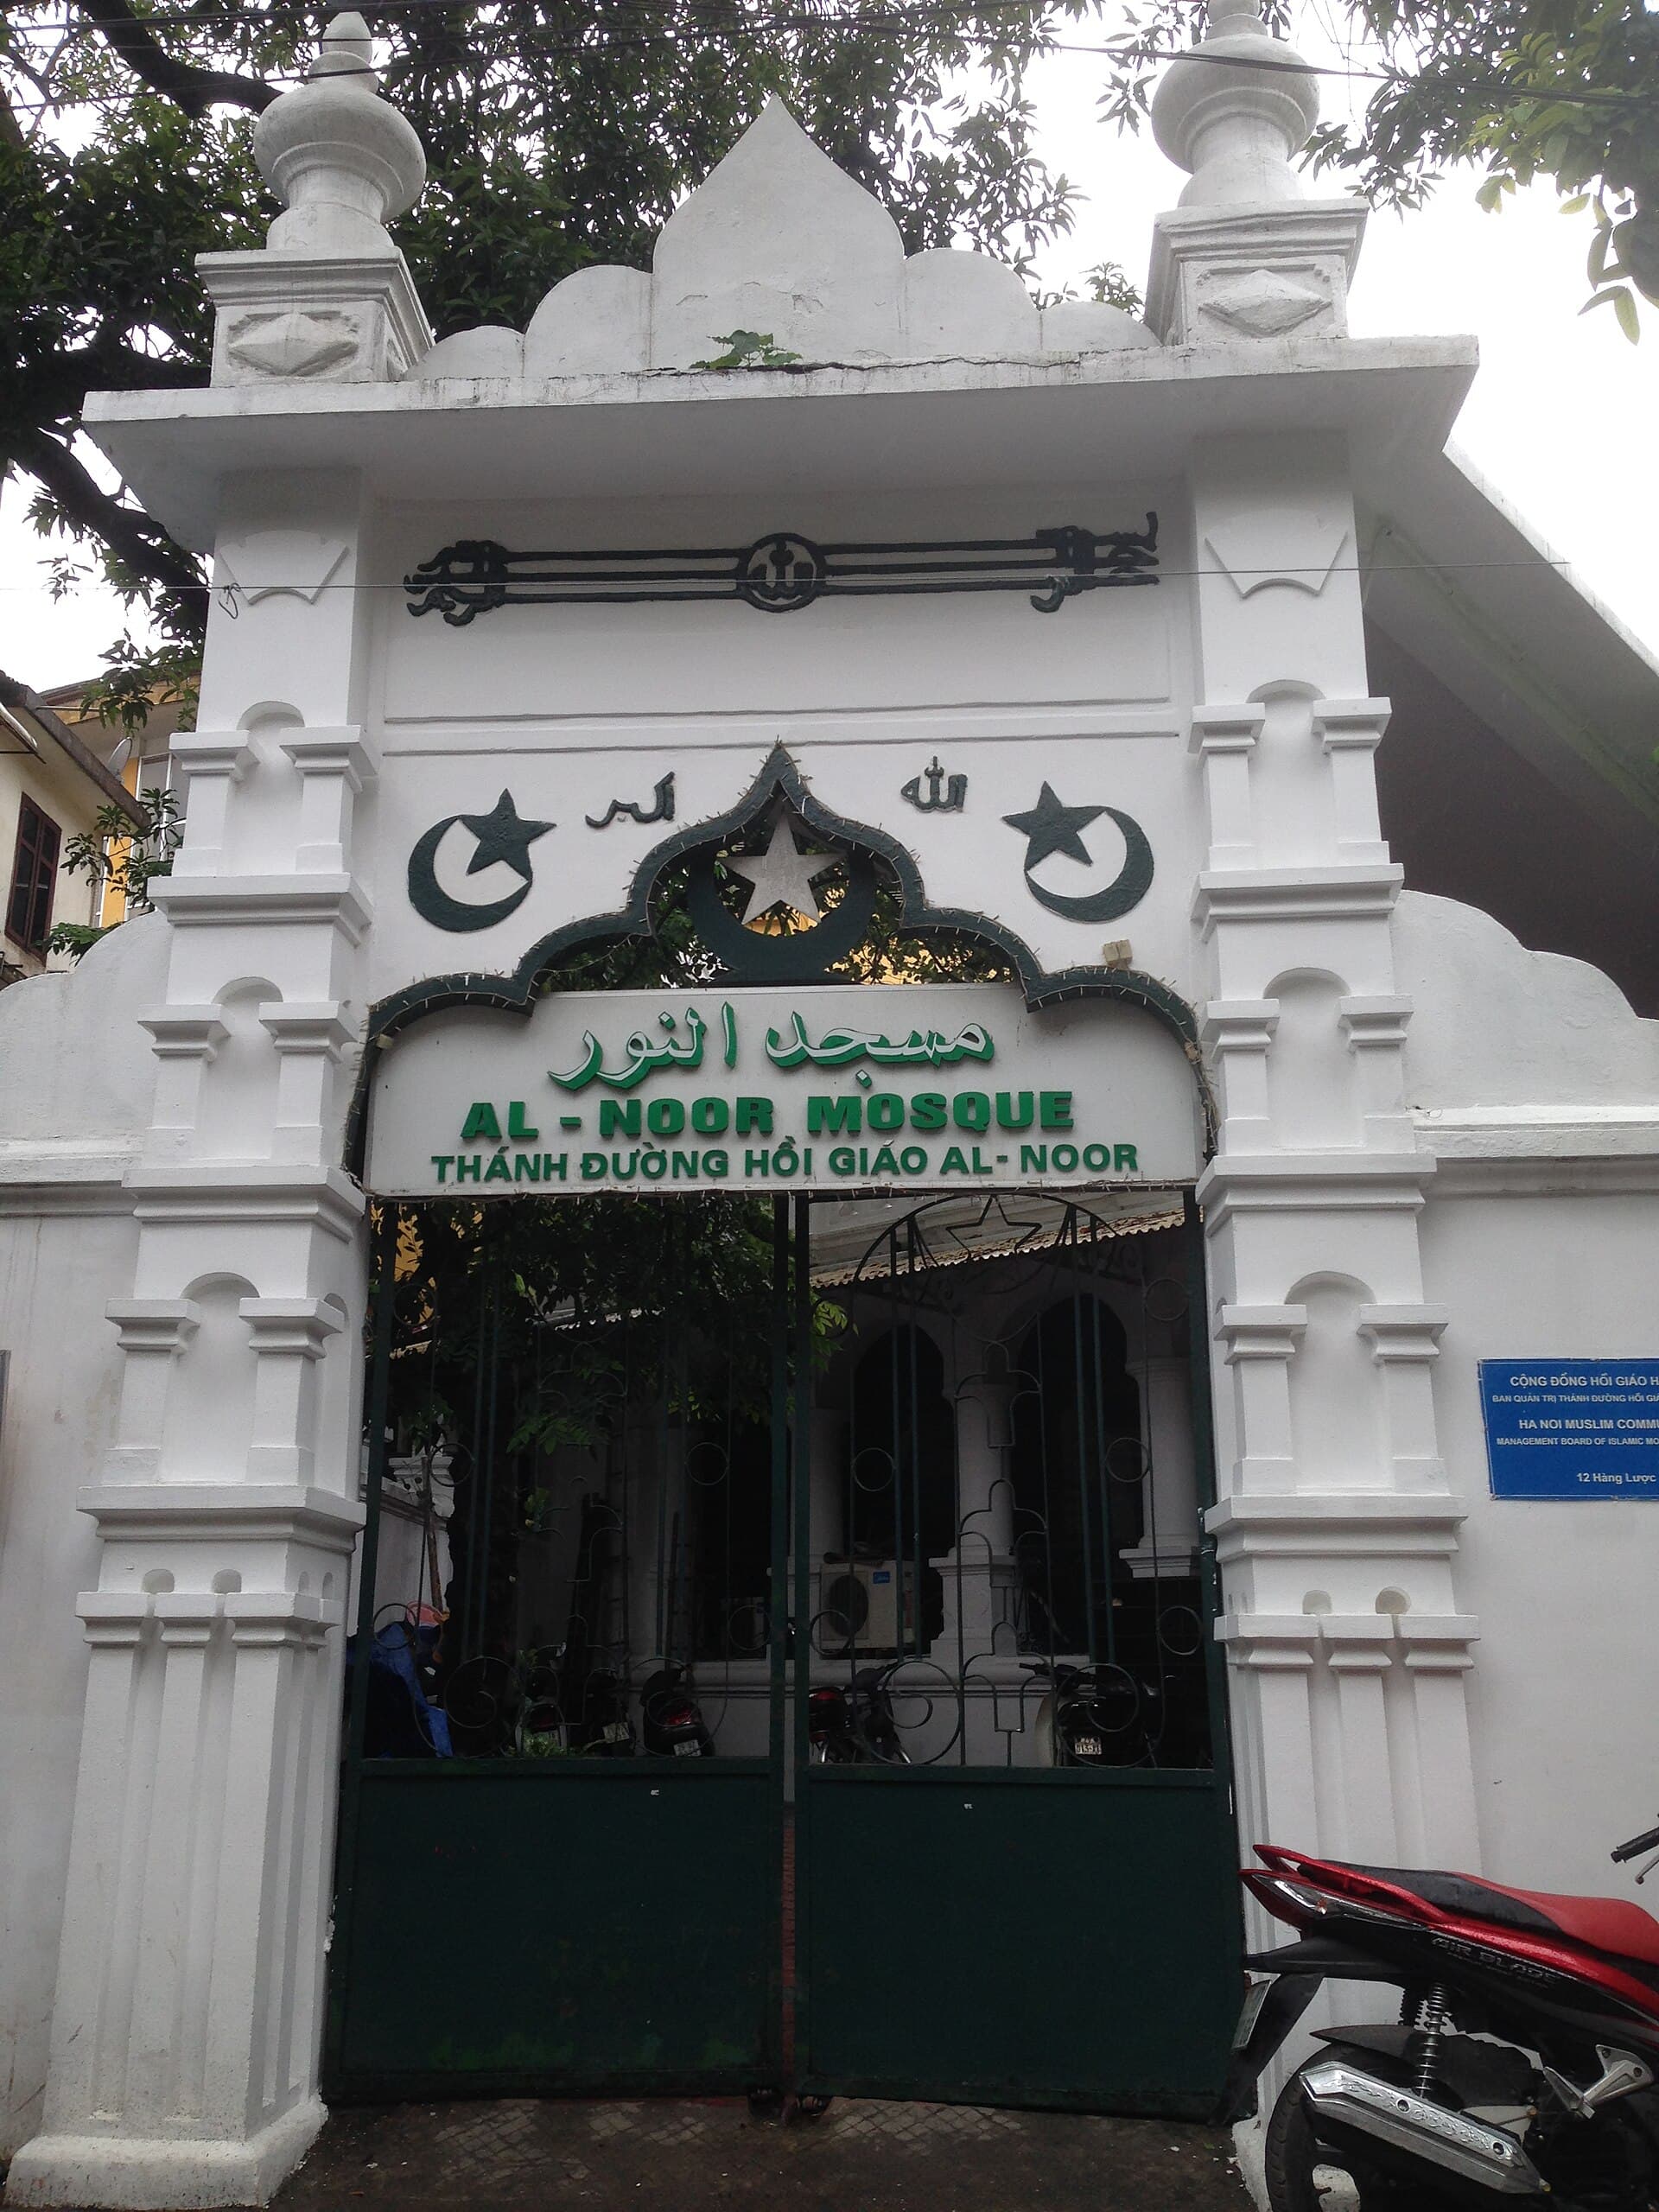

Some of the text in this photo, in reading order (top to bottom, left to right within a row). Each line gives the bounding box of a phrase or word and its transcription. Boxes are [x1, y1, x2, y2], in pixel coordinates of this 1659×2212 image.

[547, 1001, 995, 1091] مسجد النور
[807, 1090, 1074, 1133] MOSQUE
[431, 1146, 568, 1182] THÁNH
[580, 1141, 729, 1179] ĐƯỜNG
[745, 1135, 811, 1176] HỒI
[829, 1140, 928, 1175] GIÁO
[1510, 1373, 1548, 1389] CỘNG
[1616, 1373, 1648, 1386] GIÁO
[1519, 1420, 1537, 1429] HA
[1540, 1420, 1562, 1429] NOI
[1565, 1419, 1614, 1429] MUSLIM
[1497, 1437, 1559, 1446] MANAGEMENT
[1560, 1437, 1592, 1446] BOARD
[1608, 1437, 1644, 1446] ISLAMIC
[1576, 1473, 1591, 1482] 12
[1592, 1472, 1622, 1484] Hàng
[1431, 1936, 1472, 1957] AIR
